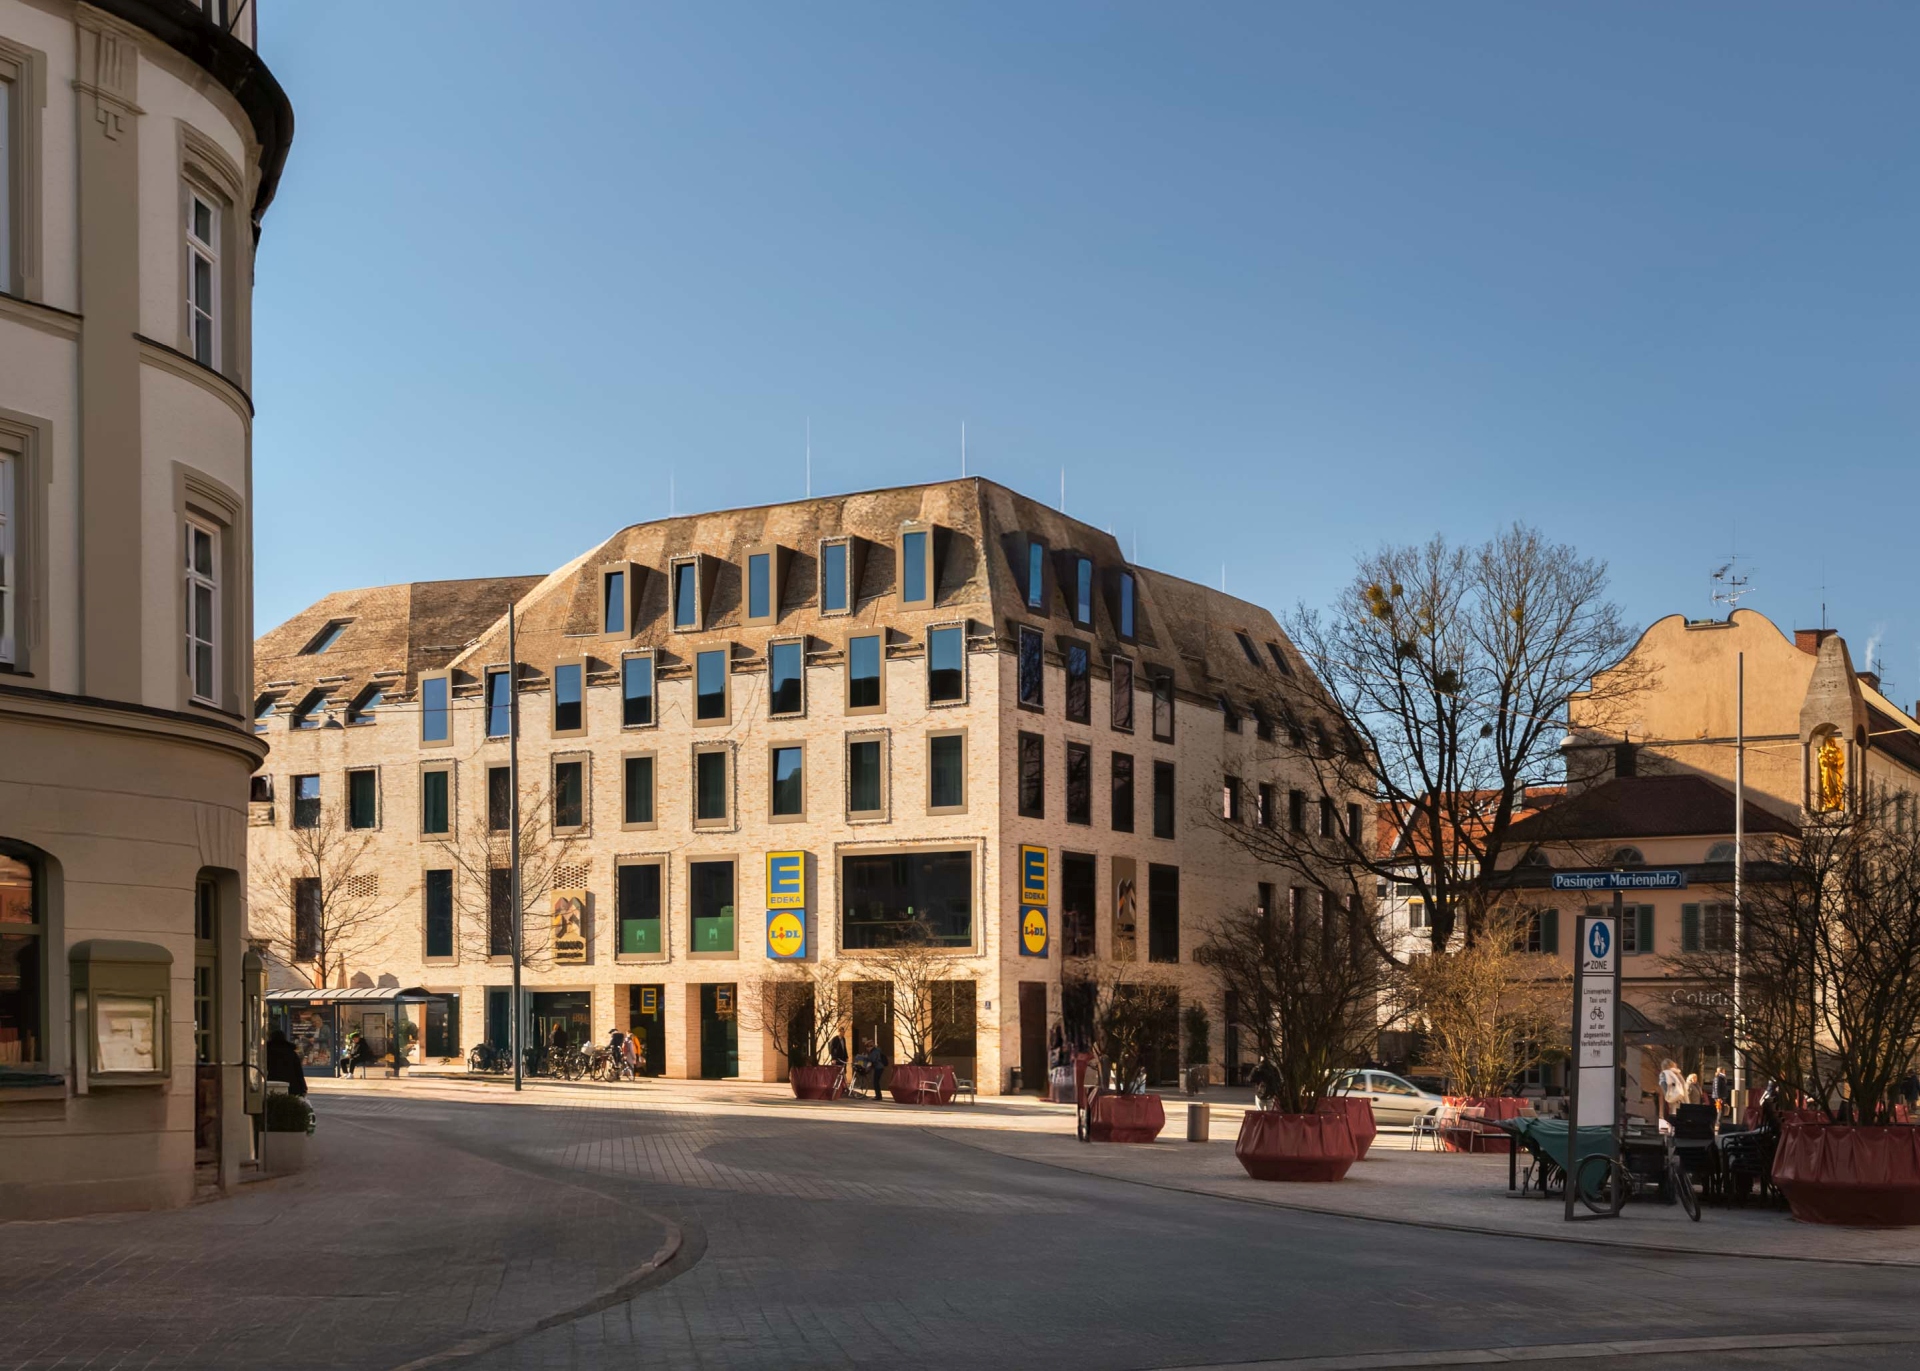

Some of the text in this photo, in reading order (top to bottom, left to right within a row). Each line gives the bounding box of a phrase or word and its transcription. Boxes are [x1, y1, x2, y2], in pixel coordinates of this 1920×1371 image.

[771, 857, 799, 893] E
[1025, 851, 1045, 890] E
[1556, 873, 1677, 888] Pasinger Marienplatz
[770, 896, 801, 904] EDEKA
[1024, 891, 1045, 900] EDEKA
[1590, 960, 1608, 970] ZONE
[1589, 996, 1607, 1004] Taxi und
[1583, 1031, 1611, 1039] abgesenkten
